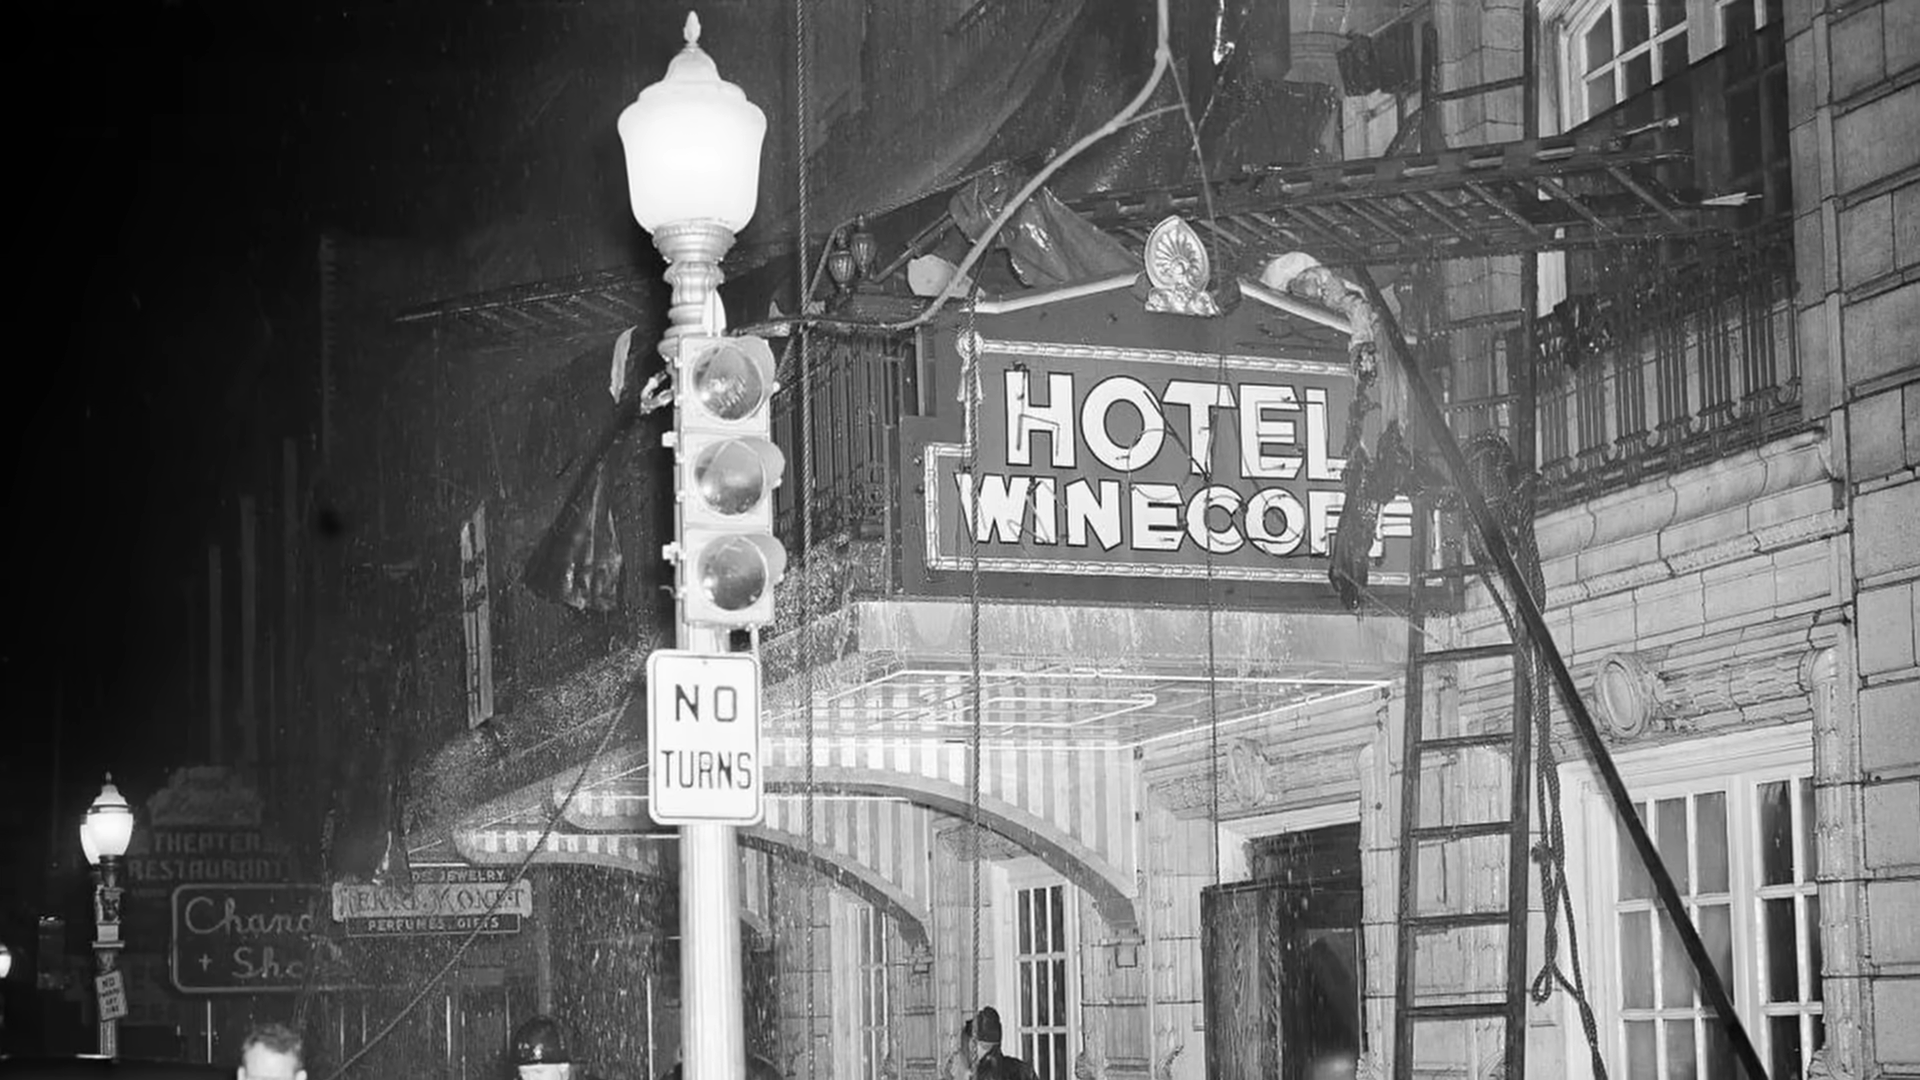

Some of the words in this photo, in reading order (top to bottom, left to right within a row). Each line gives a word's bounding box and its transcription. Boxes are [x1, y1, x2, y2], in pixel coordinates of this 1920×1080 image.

[1003, 368, 1347, 481] HOTEL
[955, 472, 1413, 557] WINECOFF
[675, 683, 738, 723] NO
[661, 750, 752, 789] TURNS
[154, 832, 261, 853] THEATER
[127, 858, 282, 880] RESTAURANT
